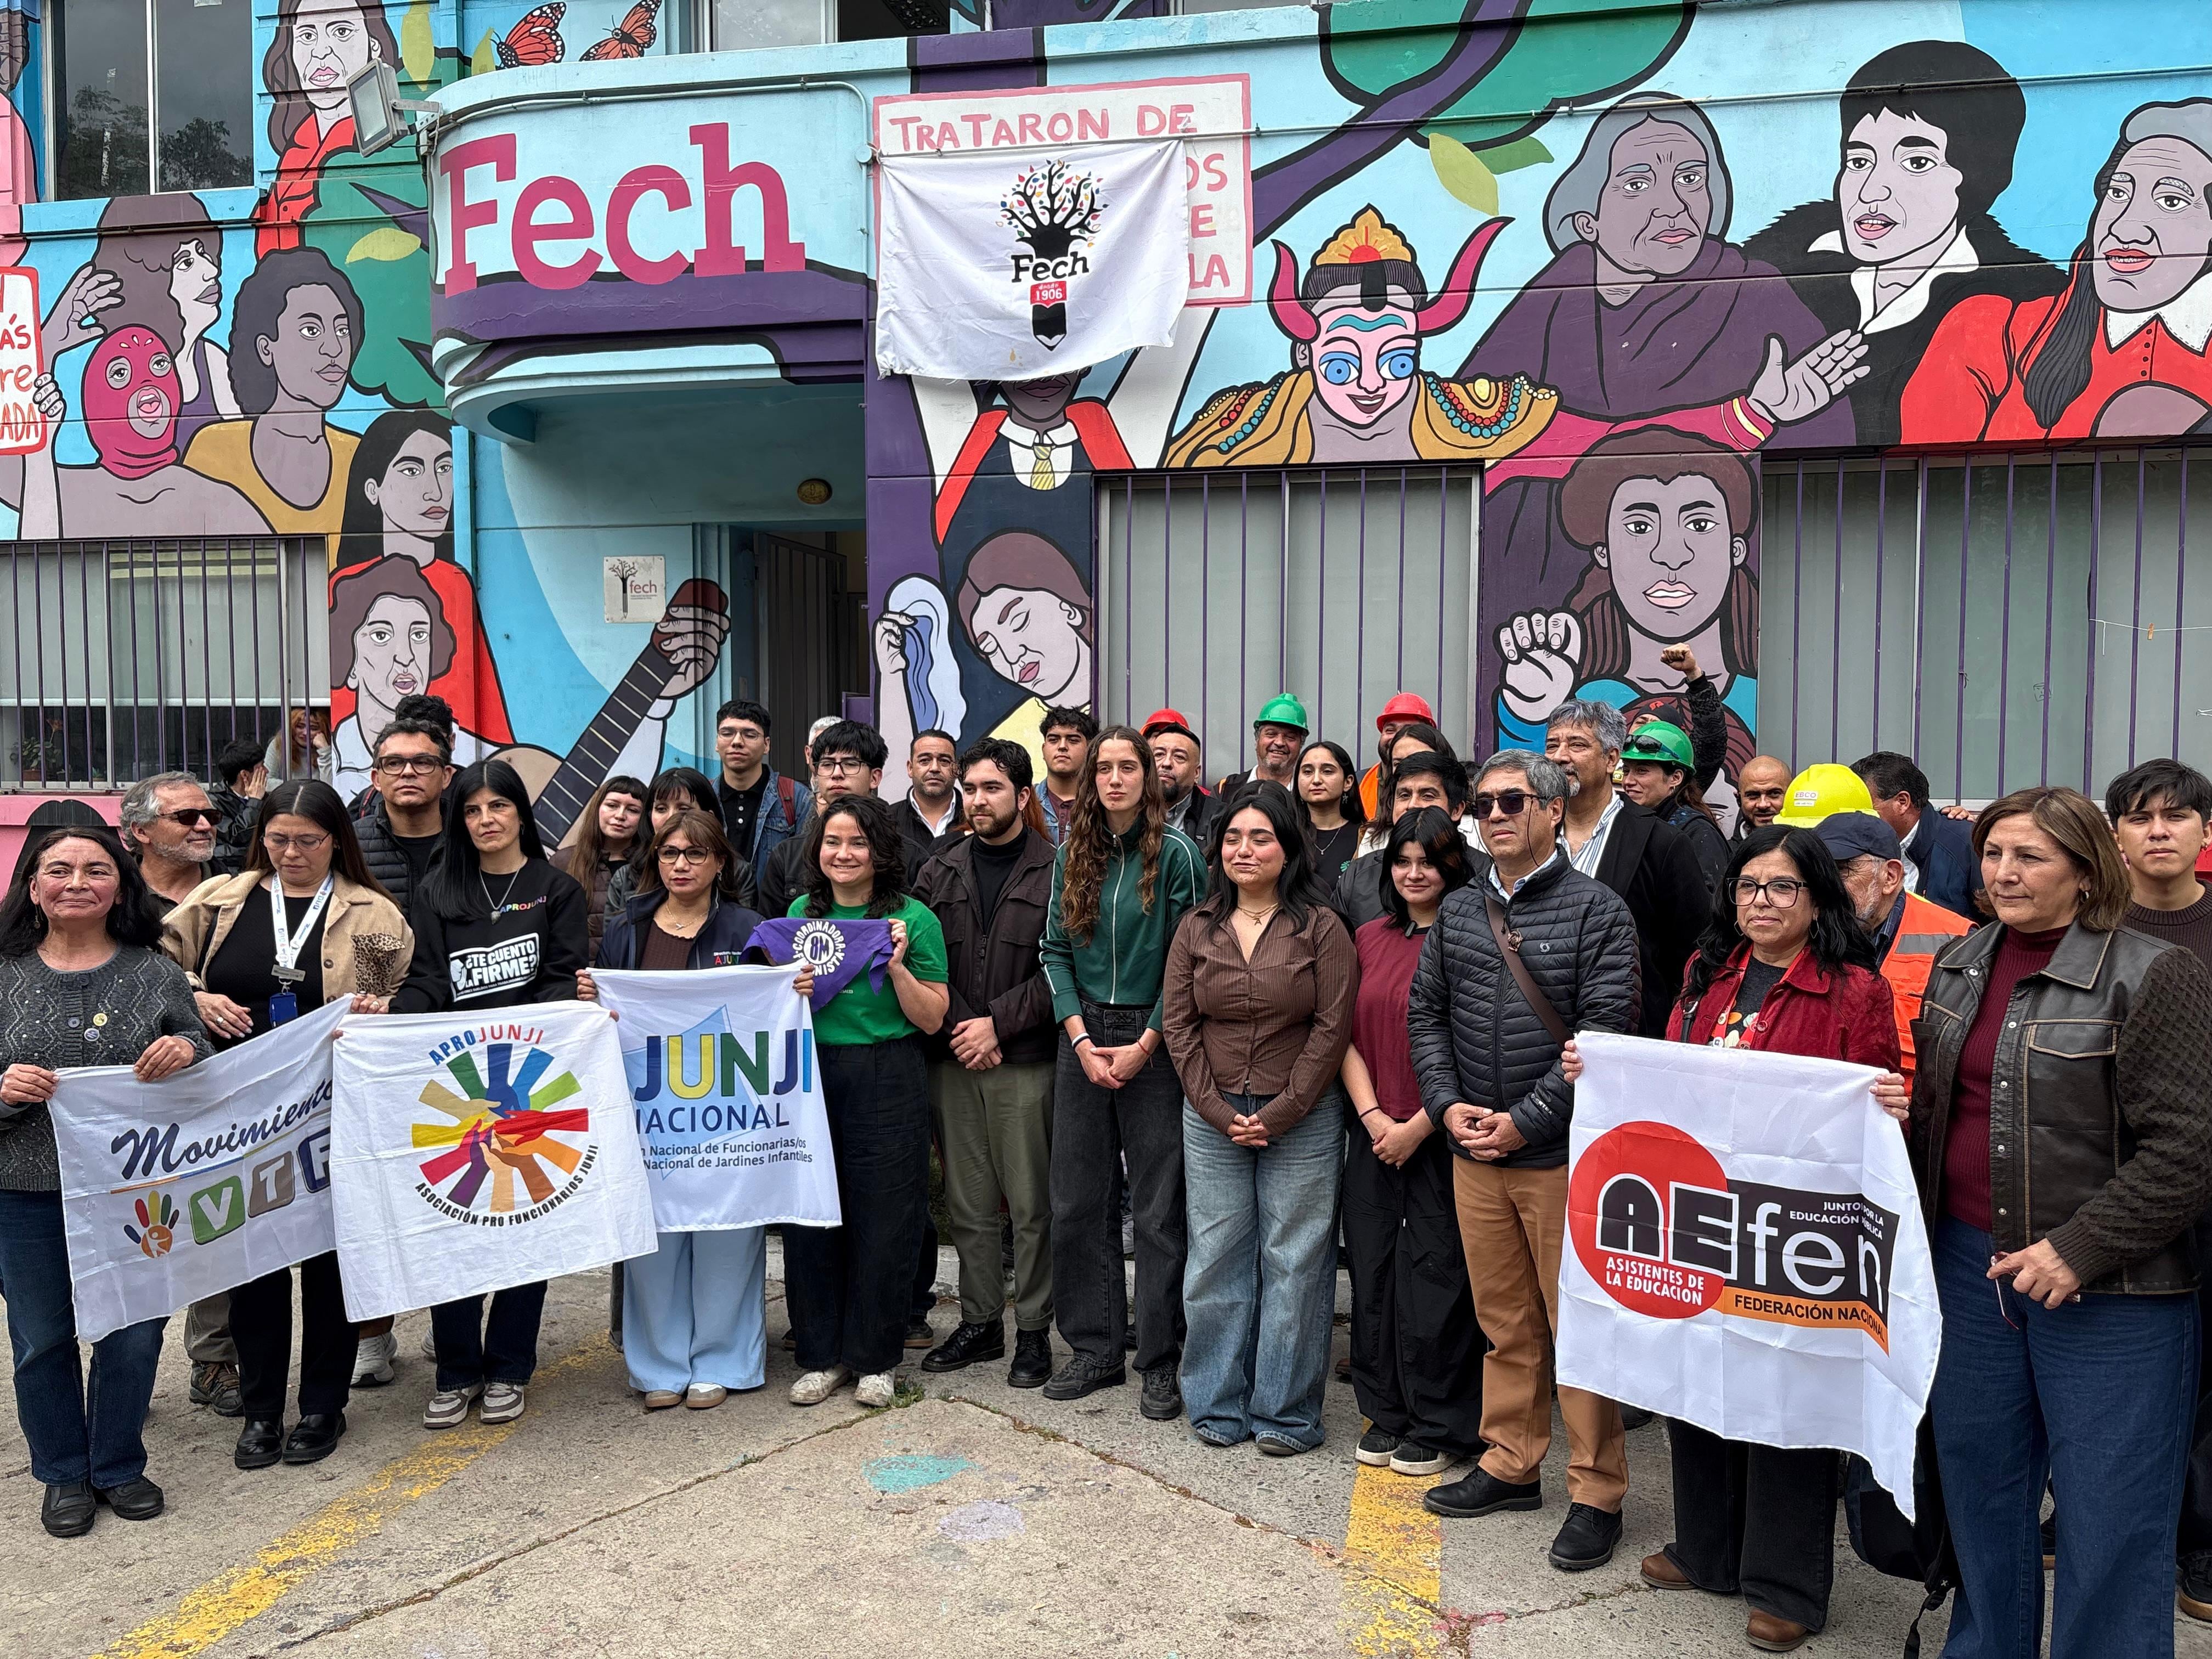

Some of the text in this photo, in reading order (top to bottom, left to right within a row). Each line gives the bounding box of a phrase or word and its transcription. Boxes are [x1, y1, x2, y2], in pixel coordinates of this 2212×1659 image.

[889, 104, 1197, 151] TRATARON DE
[440, 123, 805, 298] Fech
[1011, 251, 1089, 283] Fech
[1036, 288, 1063, 301] 1906
[630, 580, 657, 594] fech
[792, 921, 846, 951] COORDINADORA
[810, 935, 830, 962] 8M
[466, 940, 535, 969] ¿TE CUENTO
[793, 951, 845, 977] FNISTA
[465, 979, 473, 988] LA
[472, 954, 537, 986] FIRME?
[428, 1024, 544, 1066] APROJUNJI
[644, 1150, 812, 1170] Nacional de Jardines Infantiles
[650, 1143, 702, 1156] Nacional
[705, 1143, 719, 1154] de
[723, 1136, 806, 1153] Funcionarias/os
[415, 1145, 599, 1227] ASOCIACIÓN PRO FUNCIONARIOS JUNJI
[1790, 1210, 1859, 1224] EDUCACIÓN
[1875, 1214, 1884, 1227] LA
[1596, 1173, 1883, 1313] AEfen
[1606, 1256, 1704, 1291] ASISTENTES DE
[1606, 1271, 1702, 1306] LA EDUCACION
[1735, 1294, 1885, 1342] FEDERACIÓN NACIONAL
